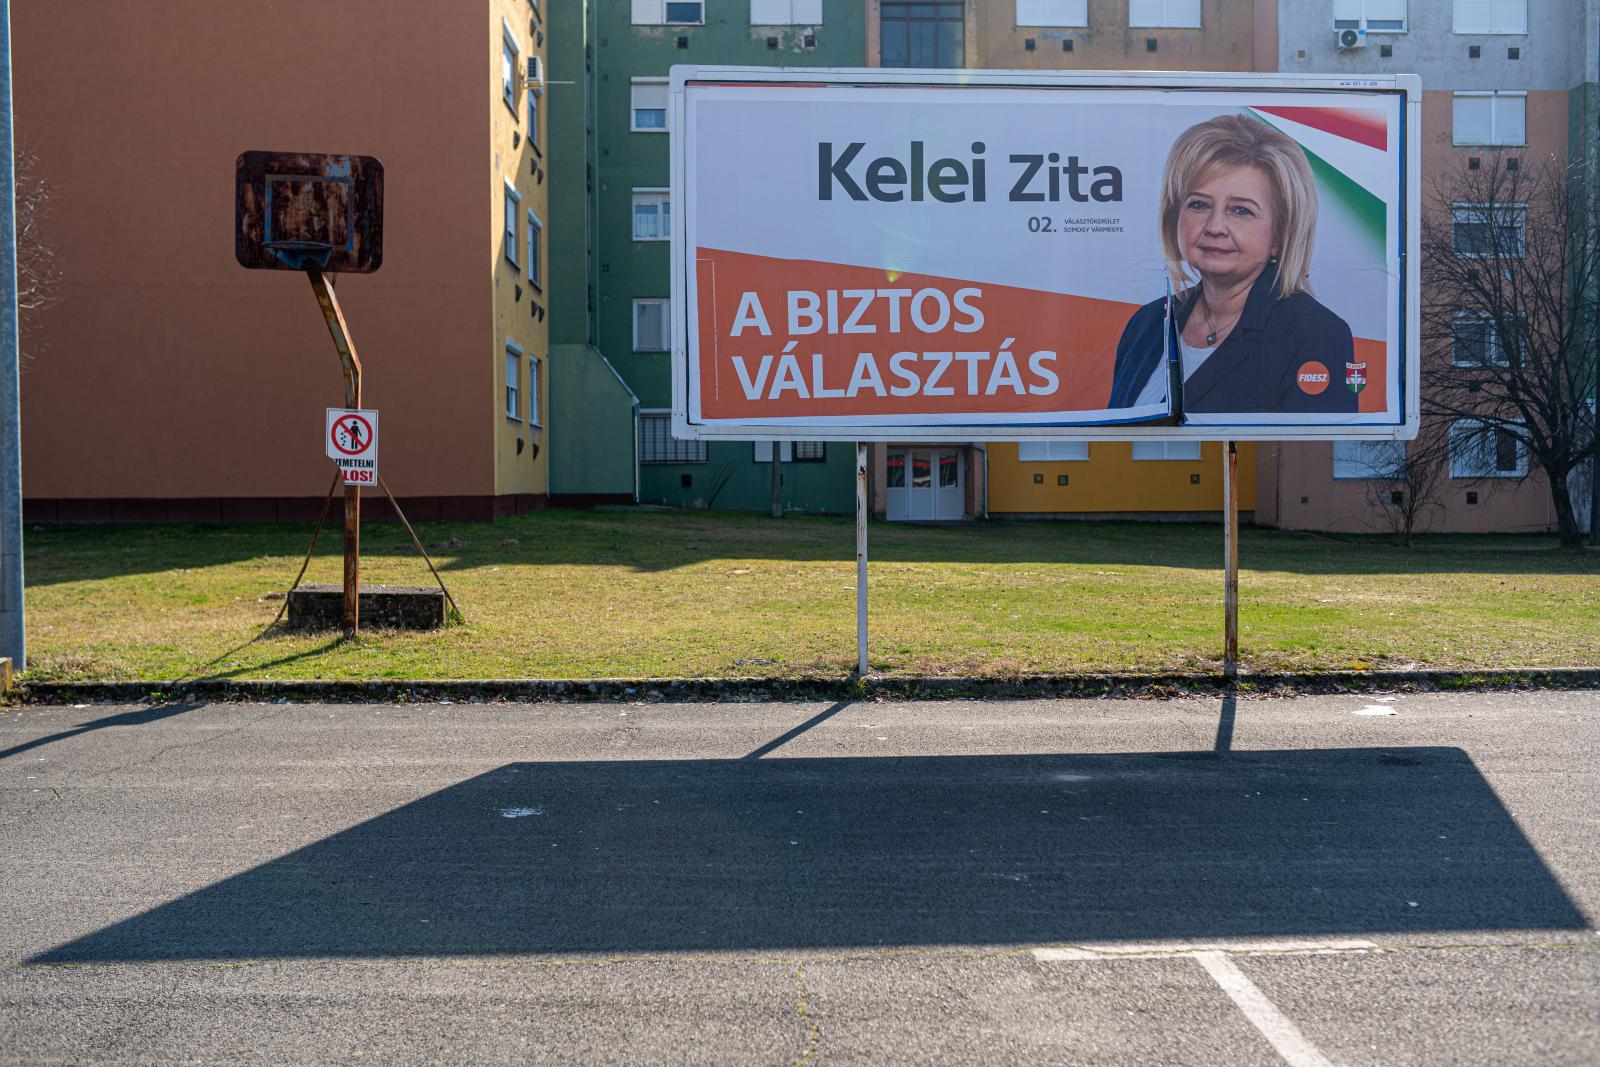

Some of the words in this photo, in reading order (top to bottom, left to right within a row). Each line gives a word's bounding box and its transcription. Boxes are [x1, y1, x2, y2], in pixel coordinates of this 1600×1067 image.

[818, 141, 986, 203] Kelei
[1008, 152, 1124, 203] Zita
[1028, 216, 1057, 233] 02.
[1064, 217, 1120, 225] VÁLASZTÓKERÜLET
[1091, 225, 1124, 233] VÁRMEGYE
[729, 291, 773, 337] A
[787, 287, 985, 336] BIZTOS
[730, 337, 1060, 401] VÁLASZTÁS
[1298, 373, 1328, 382] FIDESZ
